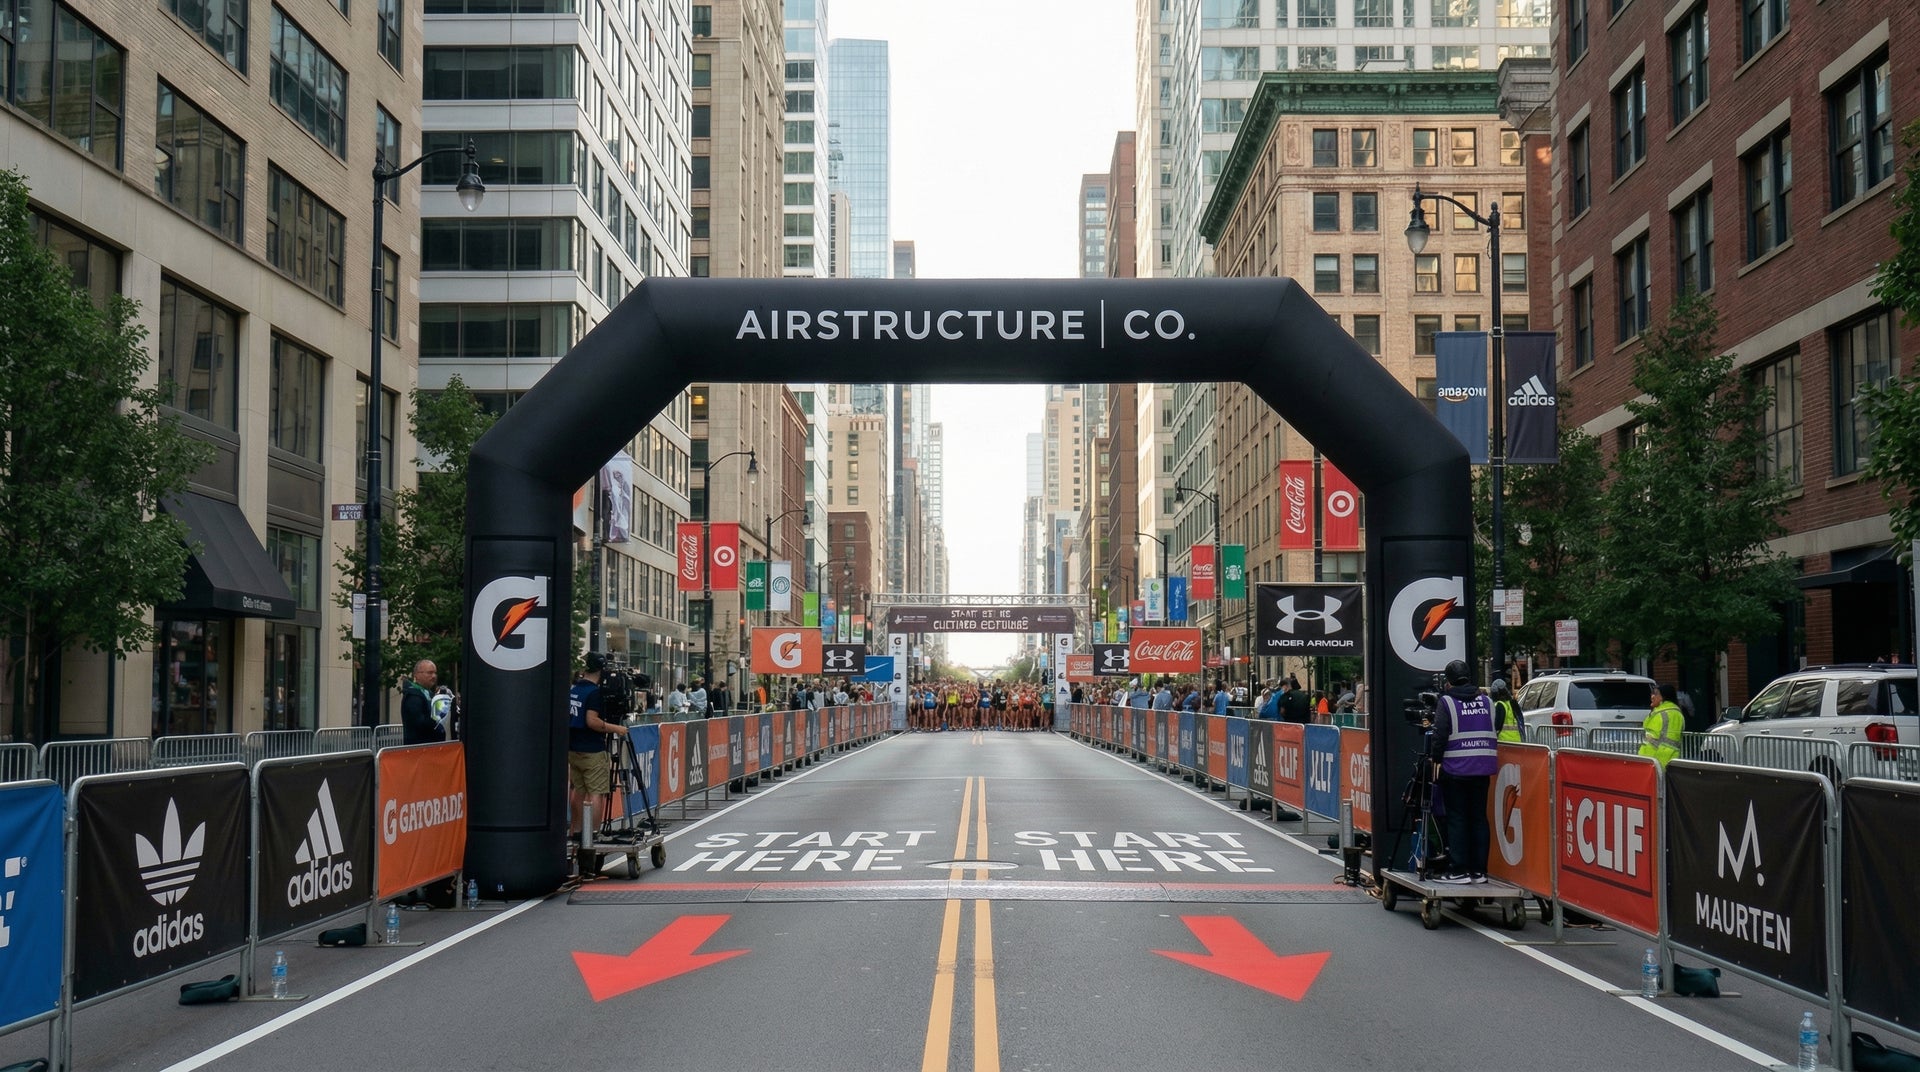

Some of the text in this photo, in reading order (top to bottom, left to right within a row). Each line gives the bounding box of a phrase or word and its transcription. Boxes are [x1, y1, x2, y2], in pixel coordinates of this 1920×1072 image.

[735, 309, 1196, 340] AIRSTRUCTURE CO.
[1507, 394, 1556, 406] adidas
[471, 575, 548, 670] G
[1388, 576, 1466, 671] G
[770, 633, 802, 669] G
[1134, 640, 1198, 661] Coca-Cola
[1267, 639, 1354, 647] UNDER ARMOUR
[384, 792, 464, 845] G GATORADE
[1495, 763, 1523, 866] G
[694, 831, 937, 847] START
[1013, 831, 1243, 847] START
[1577, 798, 1645, 877] CLIF
[671, 850, 905, 872] HERE
[1038, 850, 1275, 872] HERE
[287, 855, 353, 908] adidas
[133, 909, 204, 958] adidas
[1696, 891, 1791, 954] MAURTEN
